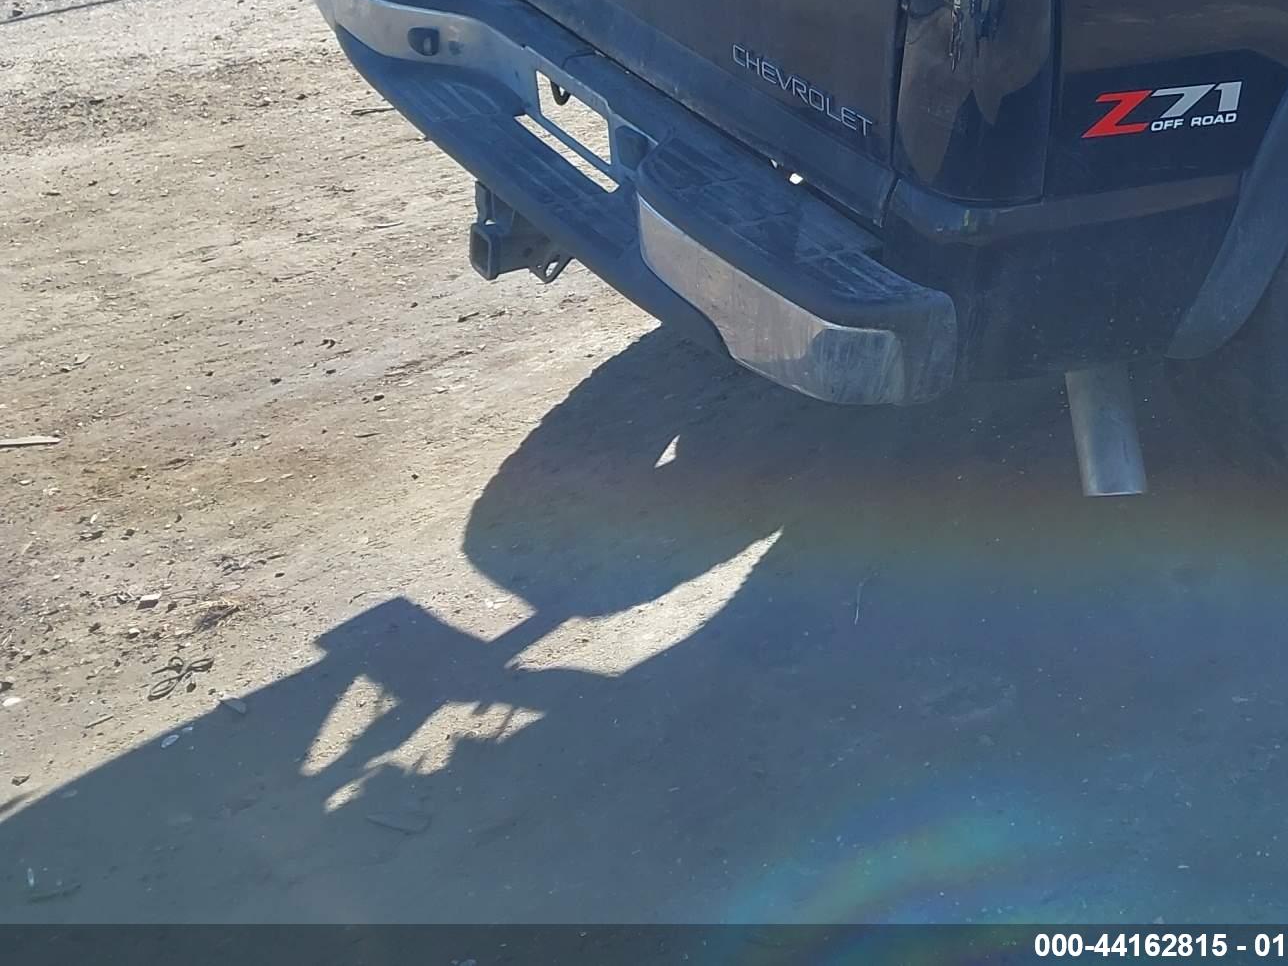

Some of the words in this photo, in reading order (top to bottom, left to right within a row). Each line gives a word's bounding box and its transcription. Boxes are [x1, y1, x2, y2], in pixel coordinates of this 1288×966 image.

[732, 44, 873, 136] CHEVROLET
[1081, 81, 1242, 138] Z71
[1151, 118, 1184, 131] OFF
[1190, 113, 1237, 127] ROAD
